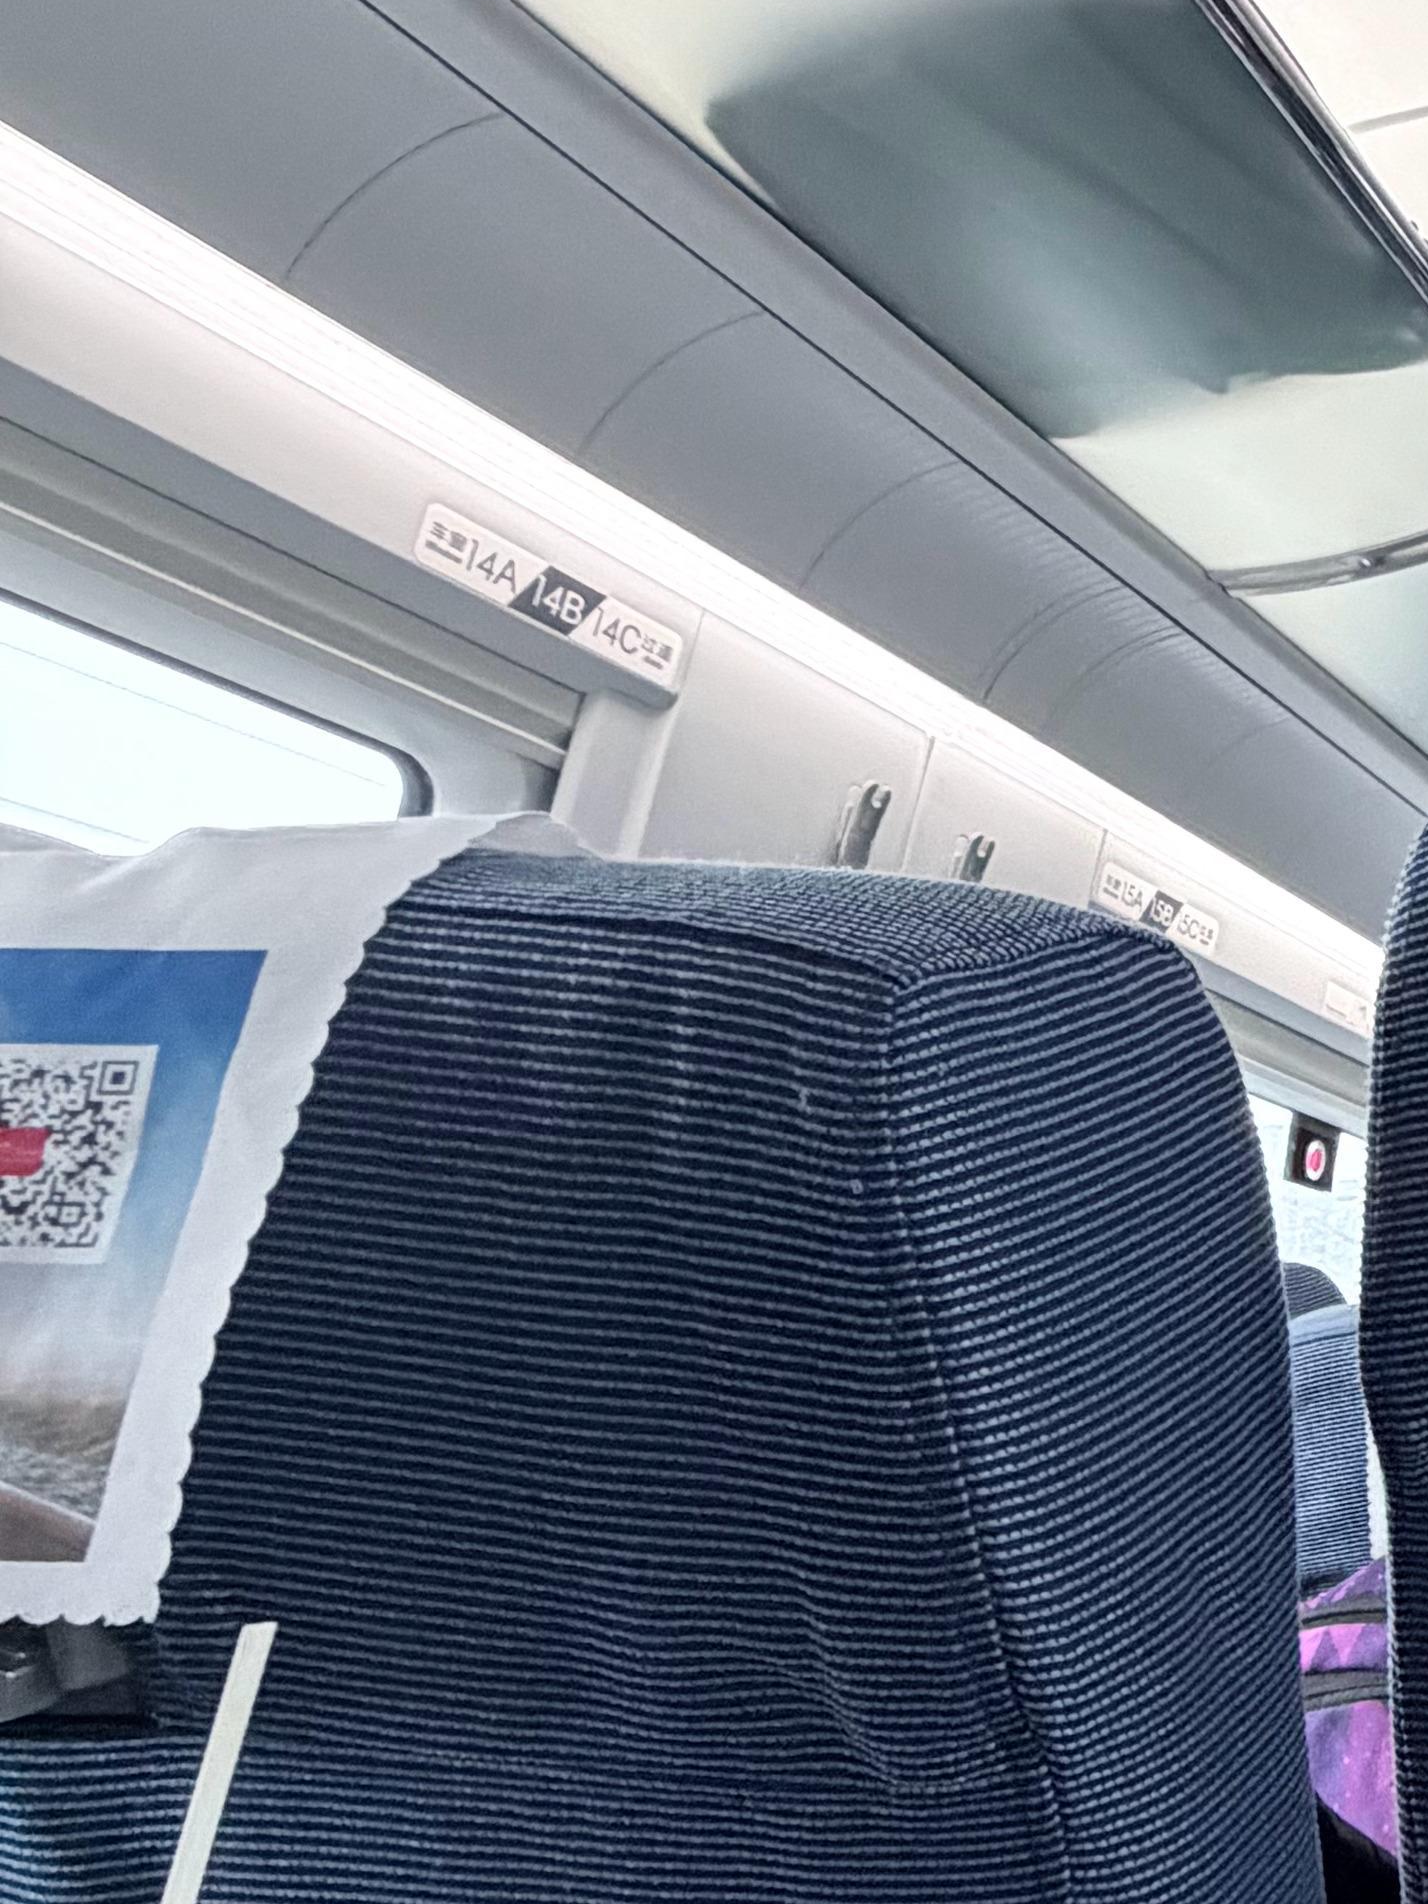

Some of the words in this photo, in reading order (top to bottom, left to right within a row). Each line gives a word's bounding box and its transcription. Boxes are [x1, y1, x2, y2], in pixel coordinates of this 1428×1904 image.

[466, 539, 517, 595] 14A
[531, 574, 586, 625] 14B
[592, 607, 642, 655] 14C
